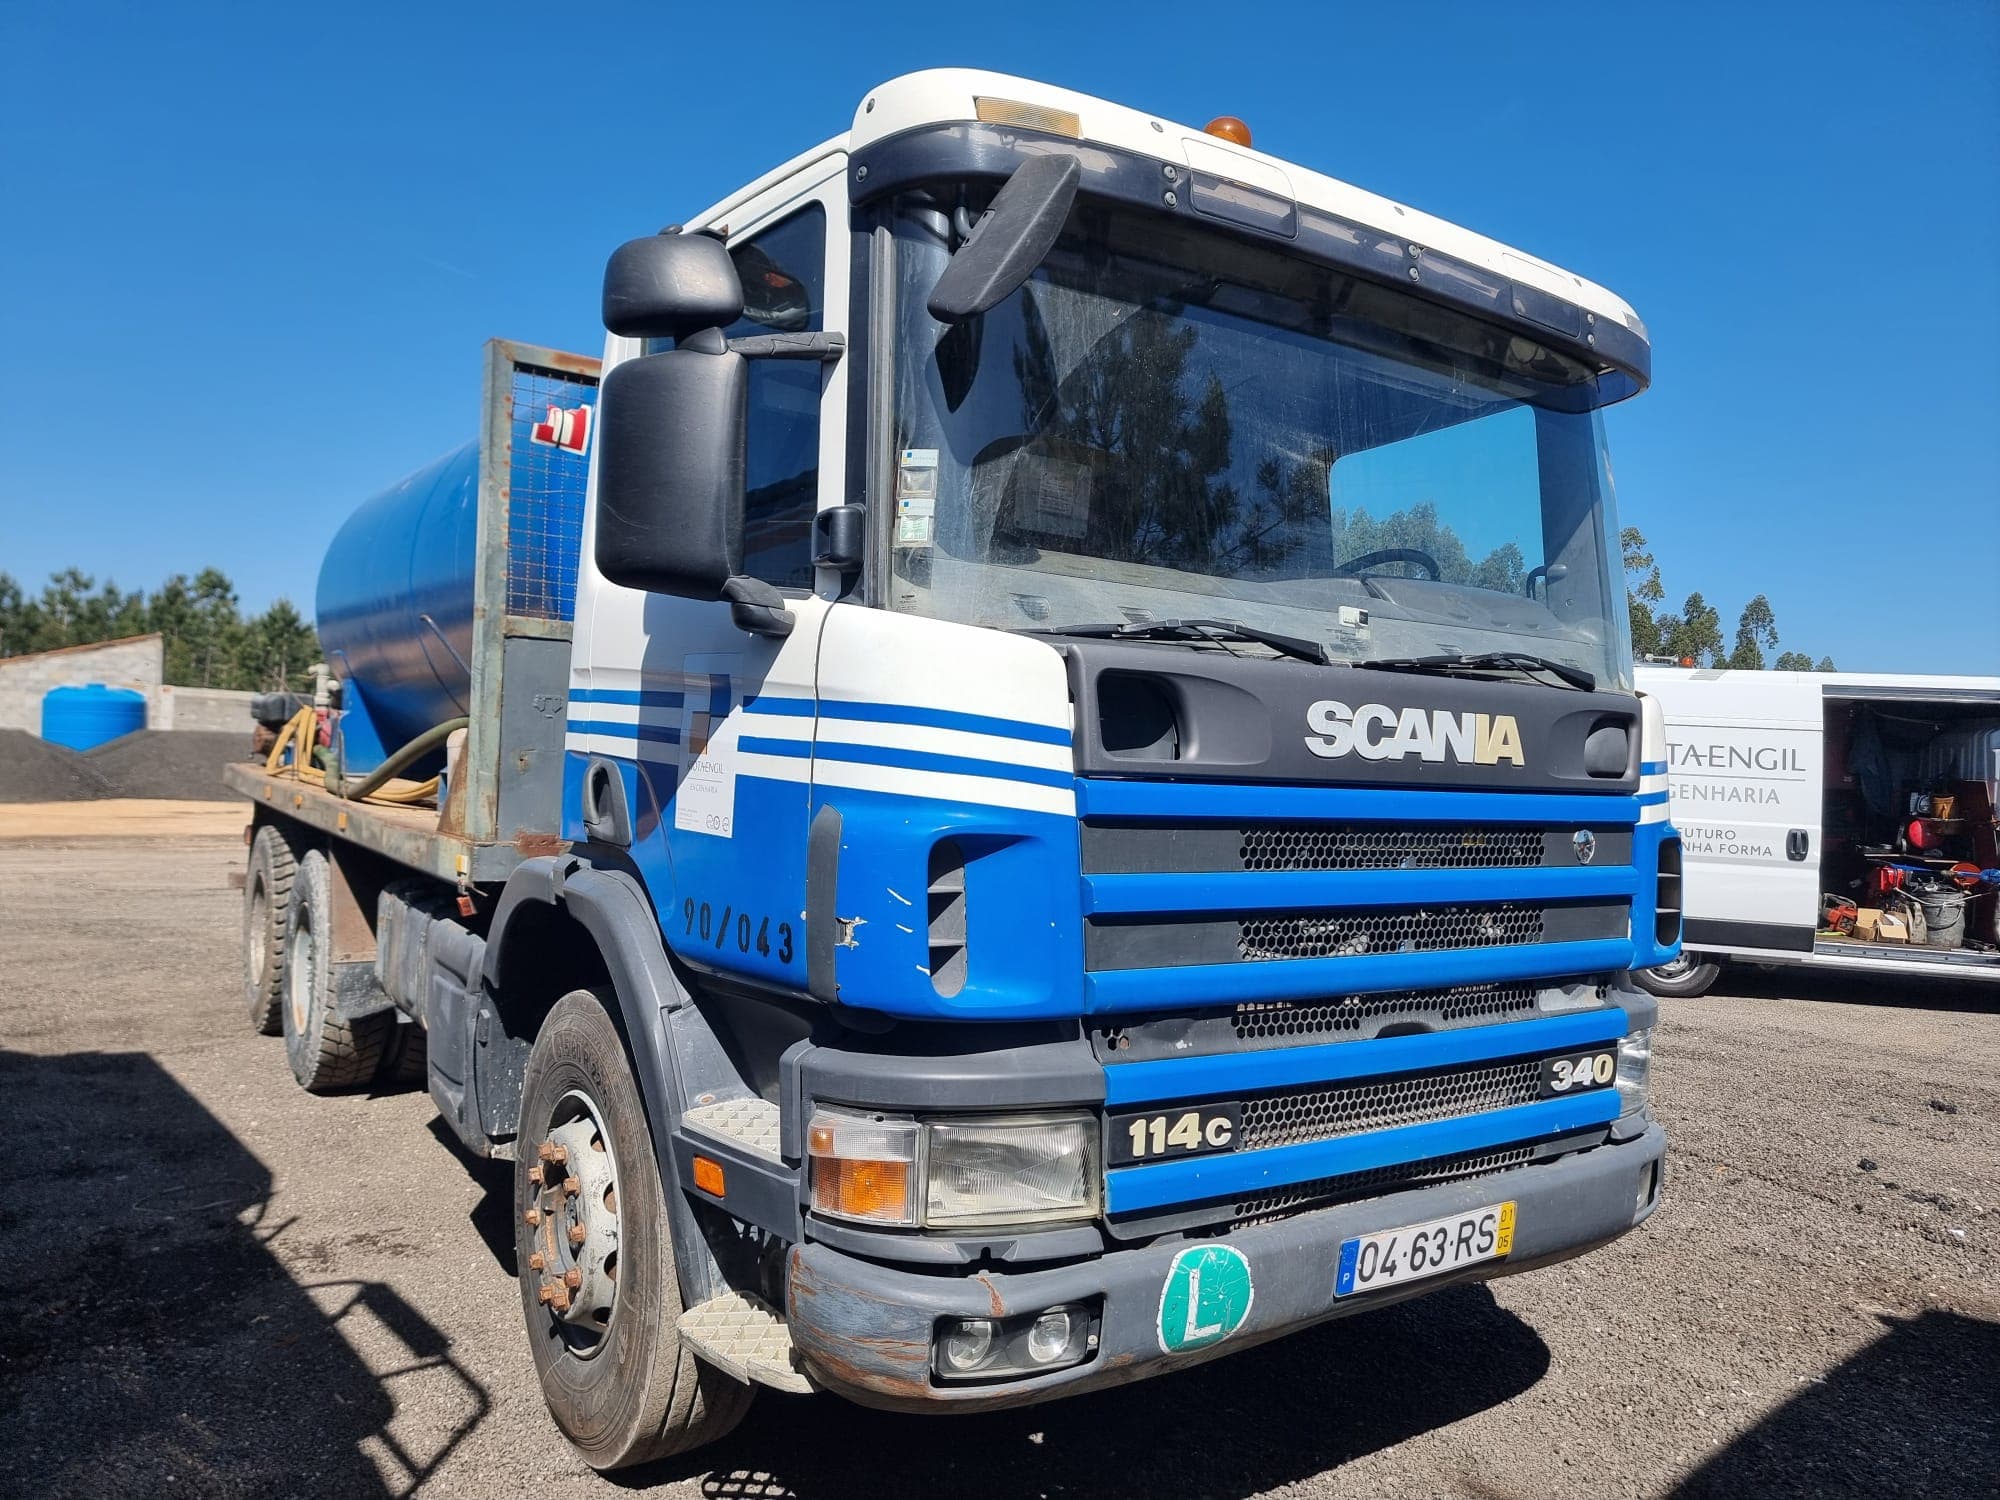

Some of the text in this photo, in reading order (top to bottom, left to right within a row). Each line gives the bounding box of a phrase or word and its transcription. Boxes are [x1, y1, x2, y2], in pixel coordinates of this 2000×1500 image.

[1304, 700, 1524, 766] SCANIA
[1719, 843, 1773, 857] FORMA
[684, 897, 793, 963] 90/043
[1551, 1053, 1614, 1092] 340
[1500, 1208, 1513, 1223] 01
[1497, 1235, 1509, 1249] 05
[1342, 1272, 1350, 1285] P
[1183, 1267, 1223, 1342] L
